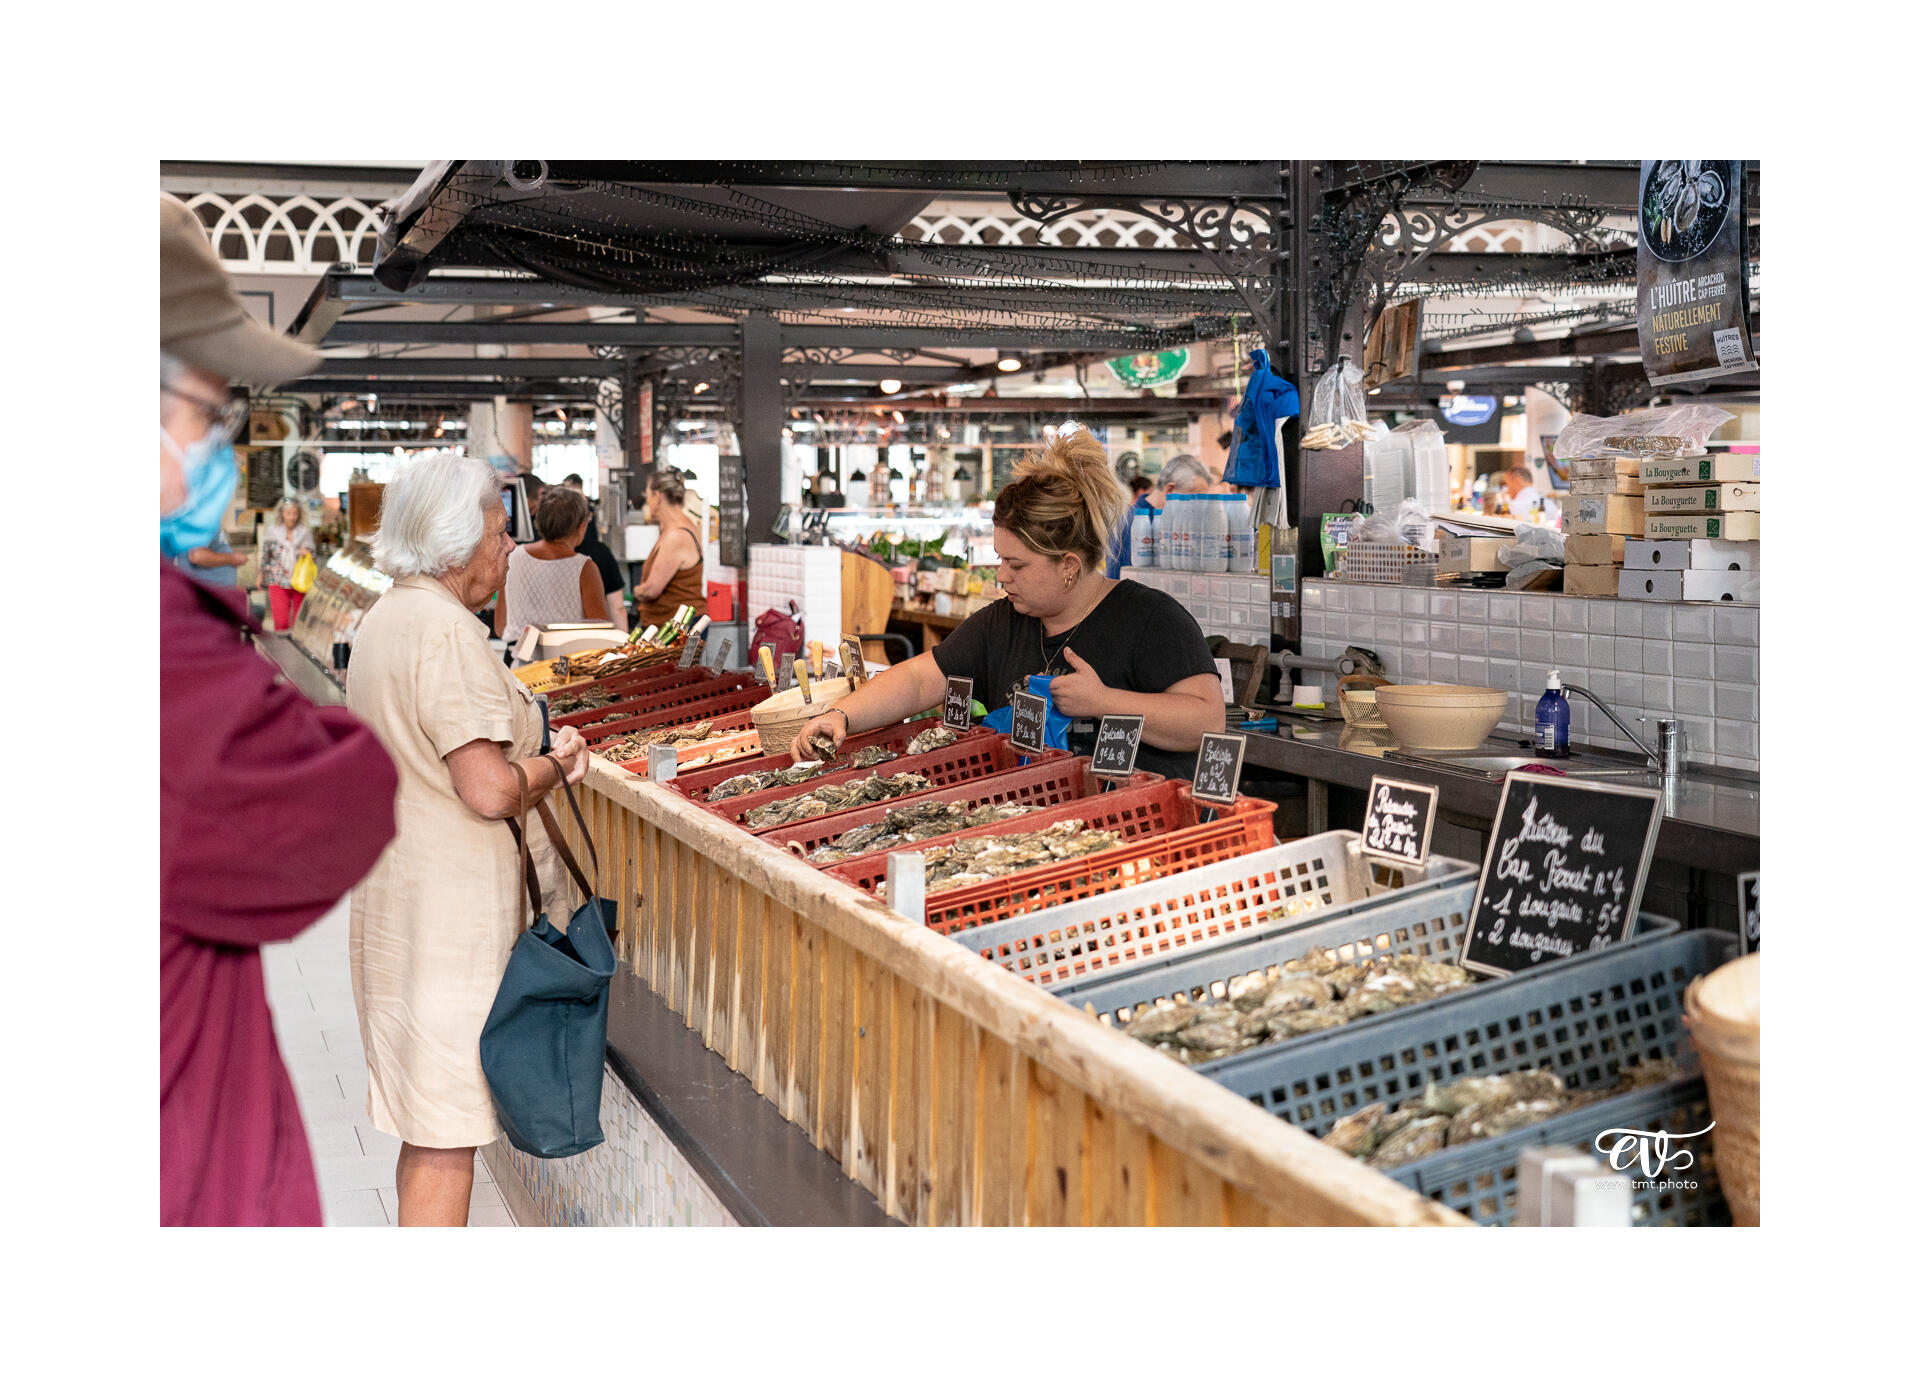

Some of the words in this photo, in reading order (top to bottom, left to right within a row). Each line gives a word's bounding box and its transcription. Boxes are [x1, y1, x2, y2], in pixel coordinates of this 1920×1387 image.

[1698, 272, 1725, 288] ARCACHON
[1651, 278, 1697, 310] L'HUÎTRE
[1698, 287, 1708, 299] CAP
[1708, 284, 1727, 297] FERRET
[1652, 303, 1721, 333] NATURELLEMENT
[1655, 333, 1688, 355] FESTIVE
[1645, 467, 1652, 478] La
[1654, 467, 1691, 480] Bouyguette
[1652, 496, 1660, 505] La
[1661, 495, 1697, 508] Bouyguette
[1650, 523, 1658, 533] La
[1659, 523, 1697, 536] Bouyguette
[1581, 825, 1605, 855] du
[1497, 837, 1534, 884] Cap
[1540, 849, 1593, 893] Ferret
[1488, 918, 1506, 946] 2
